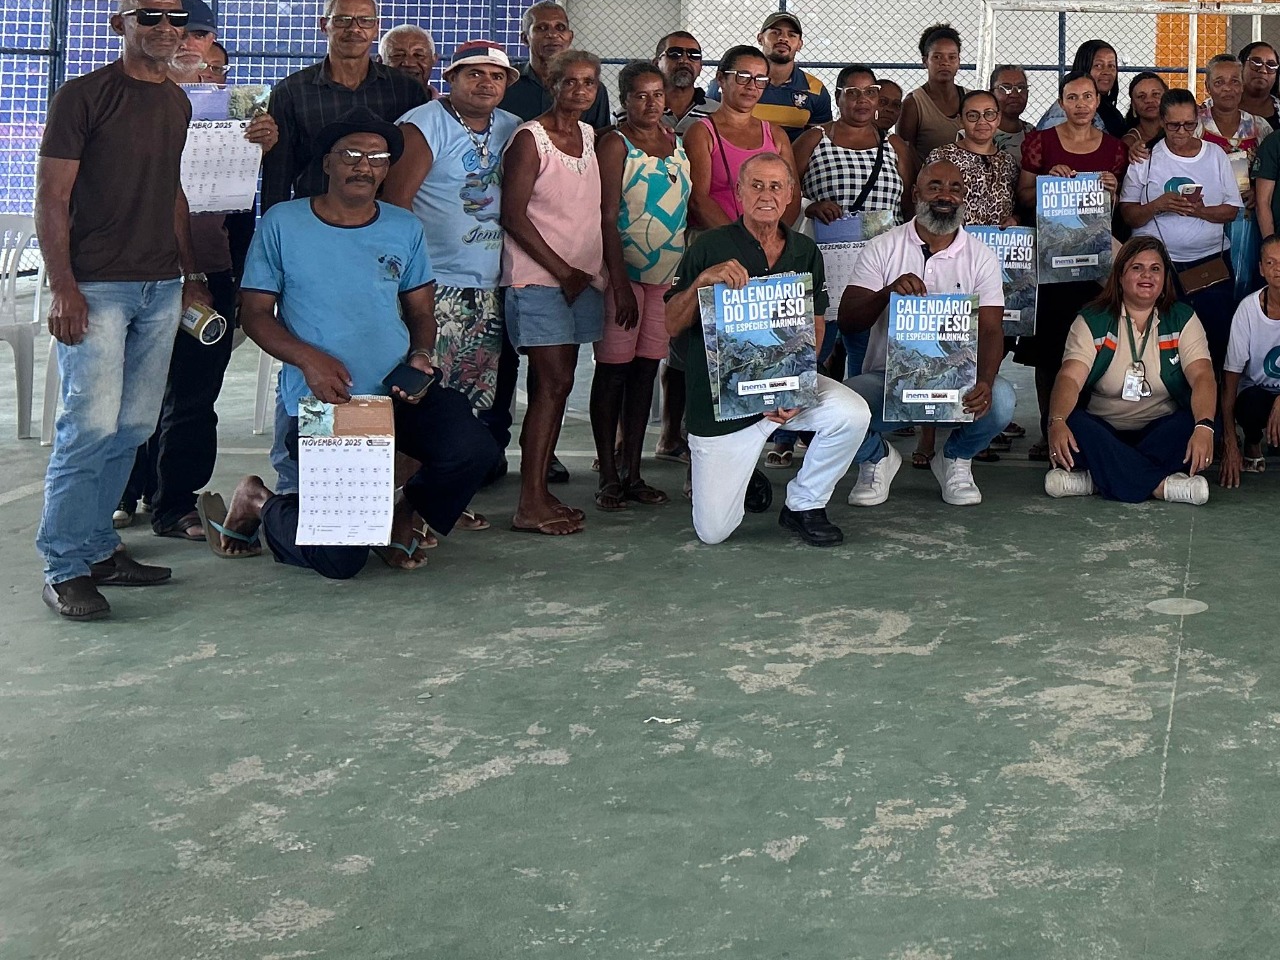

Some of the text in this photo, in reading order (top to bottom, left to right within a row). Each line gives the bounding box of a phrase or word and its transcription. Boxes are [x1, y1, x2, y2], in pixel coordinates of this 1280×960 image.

[1042, 178, 1104, 194] CALENDÁRIO
[1042, 192, 1104, 208] DO DEFESO
[1077, 207, 1104, 215] MARINHAS
[820, 243, 850, 251] DEZEMBRO
[1003, 261, 1032, 269] MARINHAS
[722, 281, 805, 305] CALENDÁRIO
[724, 298, 805, 323] DO DEFESO
[896, 297, 972, 314] CALENDÁRIO
[725, 317, 806, 334] DE ESPÉCIES MARINHAS
[896, 315, 970, 331] DO DEFESO
[896, 332, 970, 341] DE ESPÉCIES MARINHAS
[302, 438, 342, 447] NOVEMBRO
